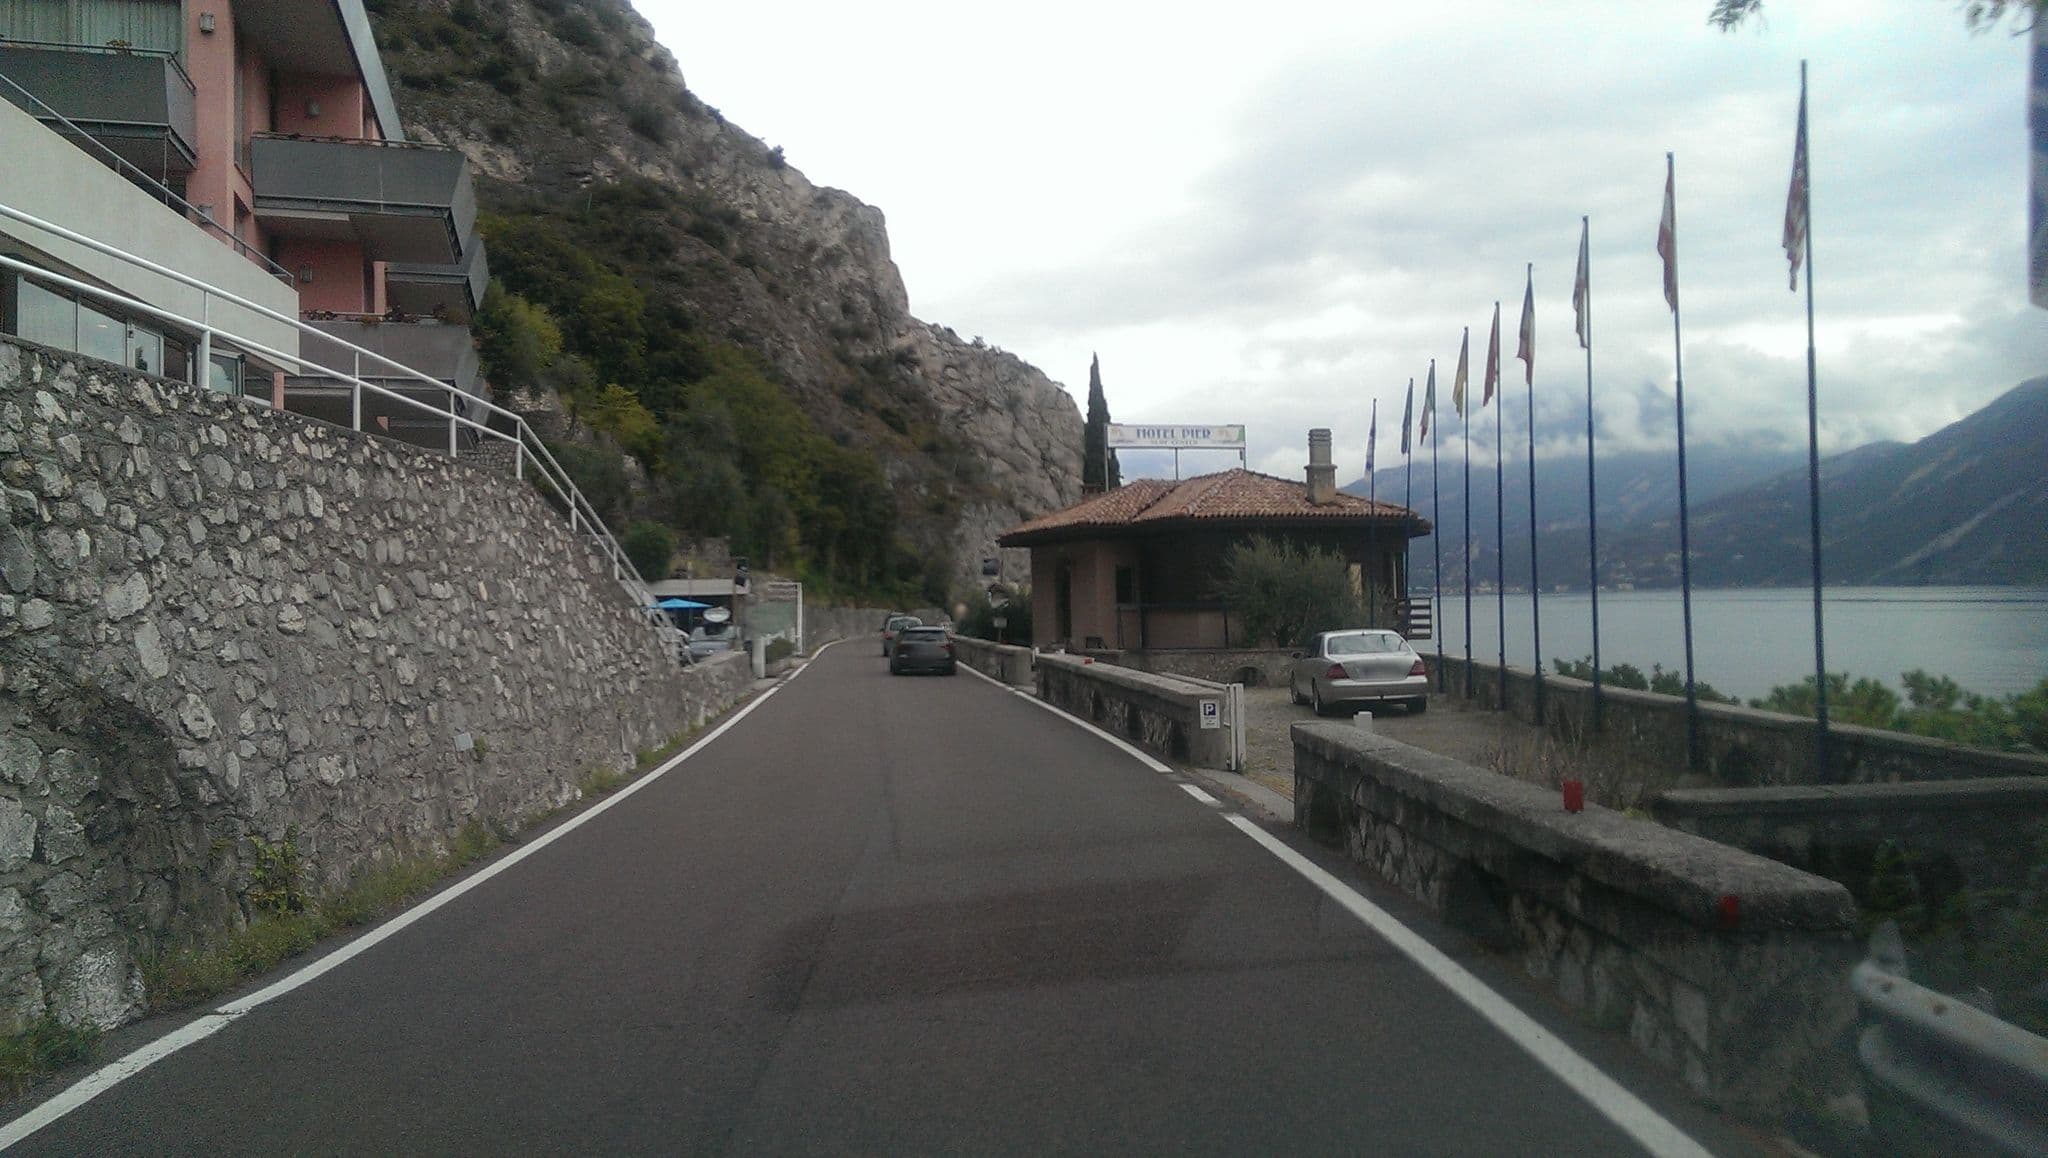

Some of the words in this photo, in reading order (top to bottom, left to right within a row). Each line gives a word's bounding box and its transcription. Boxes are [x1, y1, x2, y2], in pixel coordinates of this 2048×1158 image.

[1136, 428, 1175, 439] HOTEL
[1182, 428, 1211, 439] PIER
[1206, 704, 1214, 715] P
